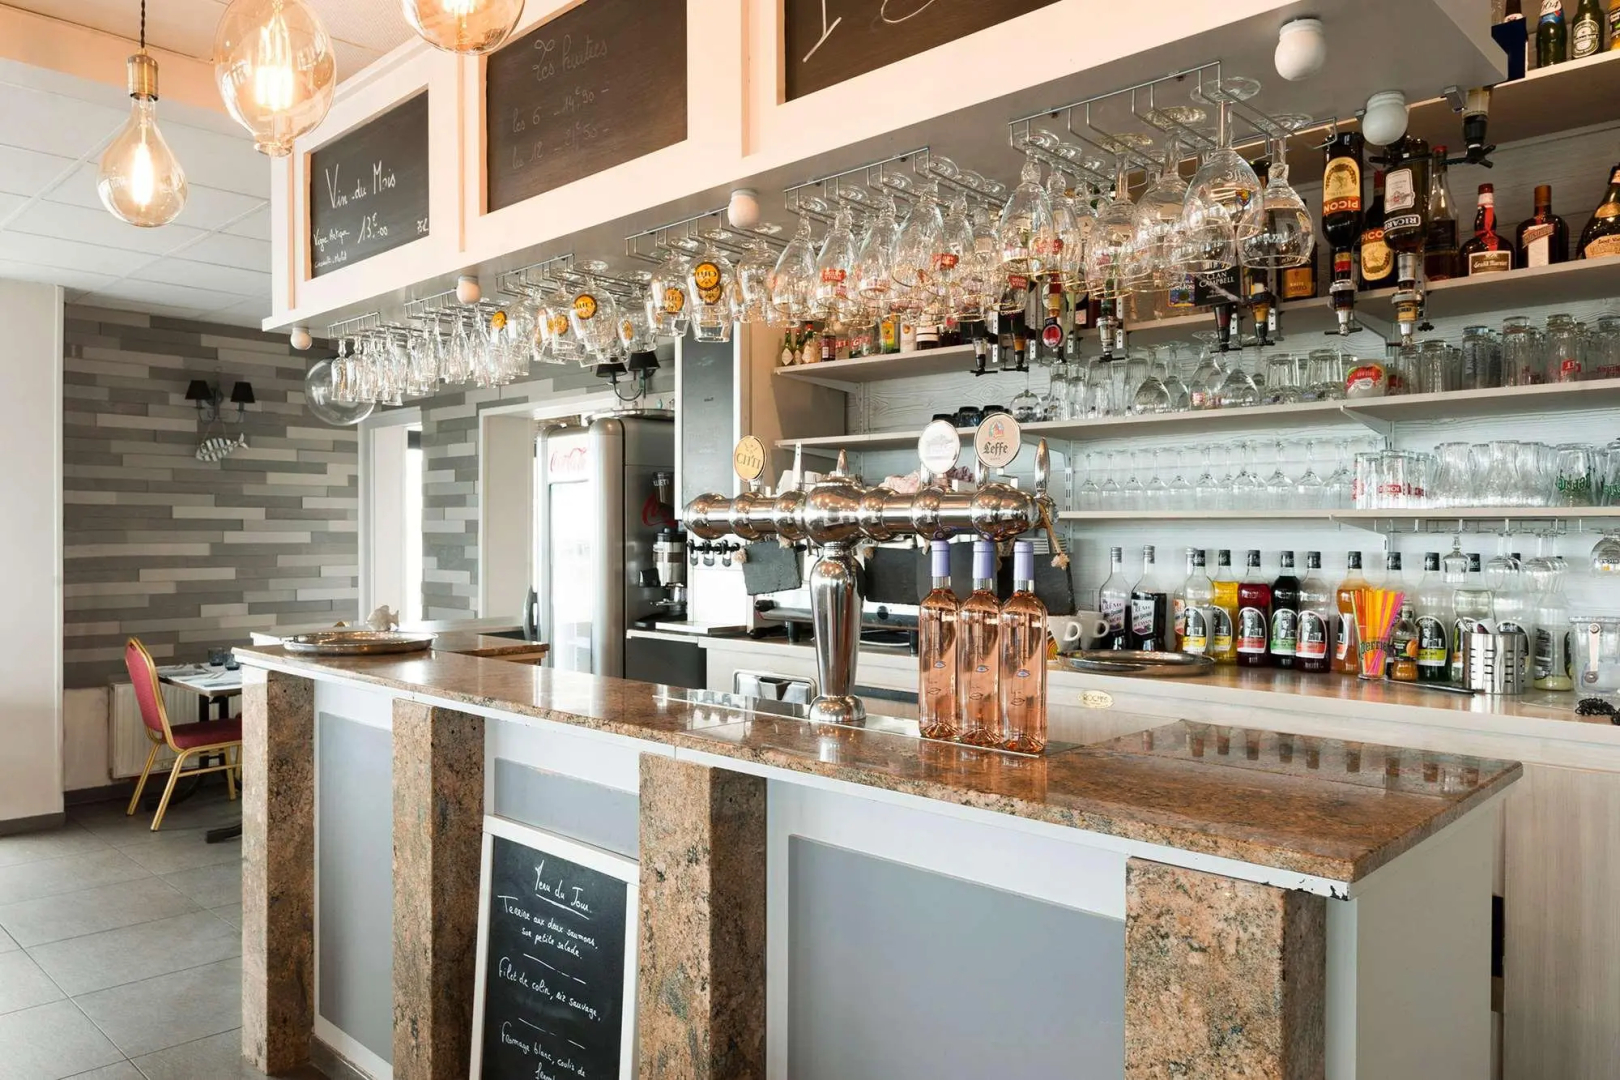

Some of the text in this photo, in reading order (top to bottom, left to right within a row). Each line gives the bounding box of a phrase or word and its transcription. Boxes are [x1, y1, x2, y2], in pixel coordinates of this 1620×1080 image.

[532, 106, 543, 125] 6
[325, 160, 396, 209] Vin du Mois
[1323, 200, 1359, 214] PICON
[1384, 217, 1417, 230] RICAR
[1361, 230, 1384, 243] PICO
[1199, 276, 1236, 288] CAMPBELL
[1206, 271, 1228, 280] CLAN
[983, 441, 1009, 457] Leffe
[554, 879, 565, 900] du
[497, 894, 531, 921] Terrine
[533, 916, 545, 926] aux
[547, 917, 564, 933] deux
[521, 927, 532, 938] sur
[534, 933, 555, 945] petite
[498, 956, 518, 981] Filet
[518, 972, 530, 988] de
[555, 991, 567, 1003] riz
[501, 1020, 531, 1055] Fromage
[556, 1058, 575, 1071] coulis
[577, 1066, 587, 1078] de
